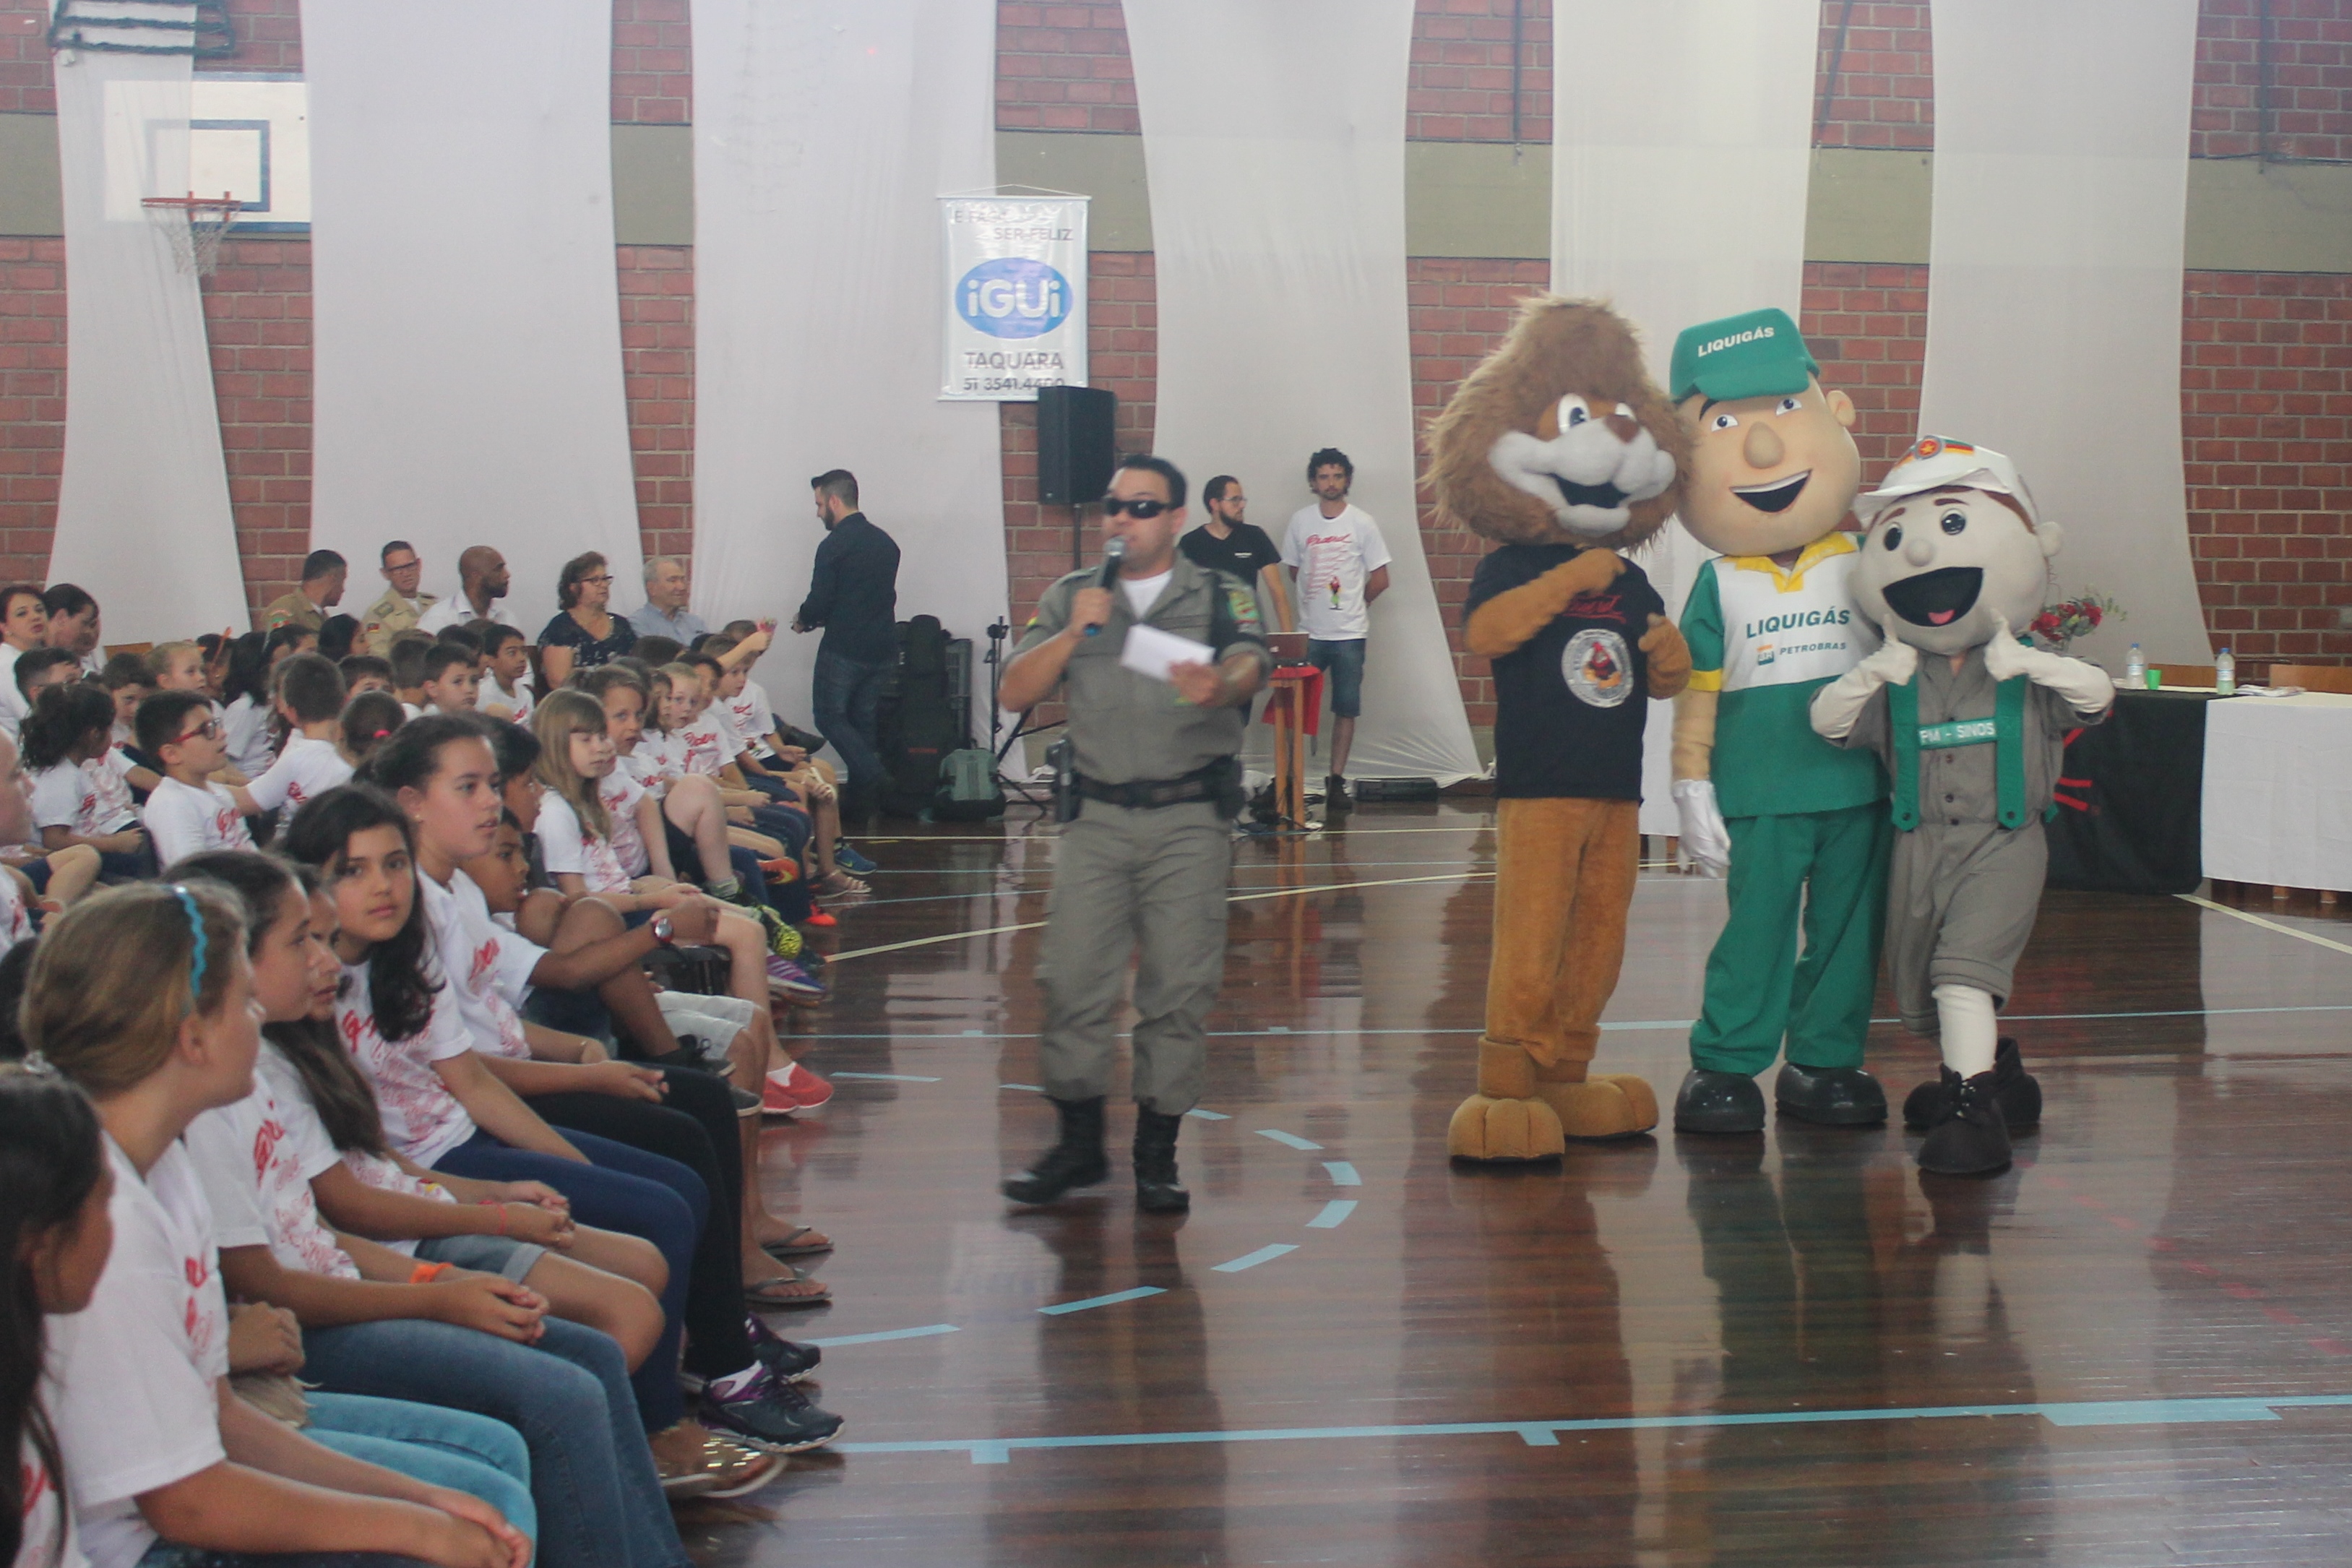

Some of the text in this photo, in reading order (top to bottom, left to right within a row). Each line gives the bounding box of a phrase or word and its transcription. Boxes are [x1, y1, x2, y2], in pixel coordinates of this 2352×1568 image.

[994, 228, 1074, 241] SER FELIZ
[1698, 326, 1775, 357] LIQUIGÁS
[965, 353, 1064, 369] TAQUARA
[1746, 606, 1851, 639] LIQUIGÁS
[1779, 642, 1847, 655] PETROBRAS
